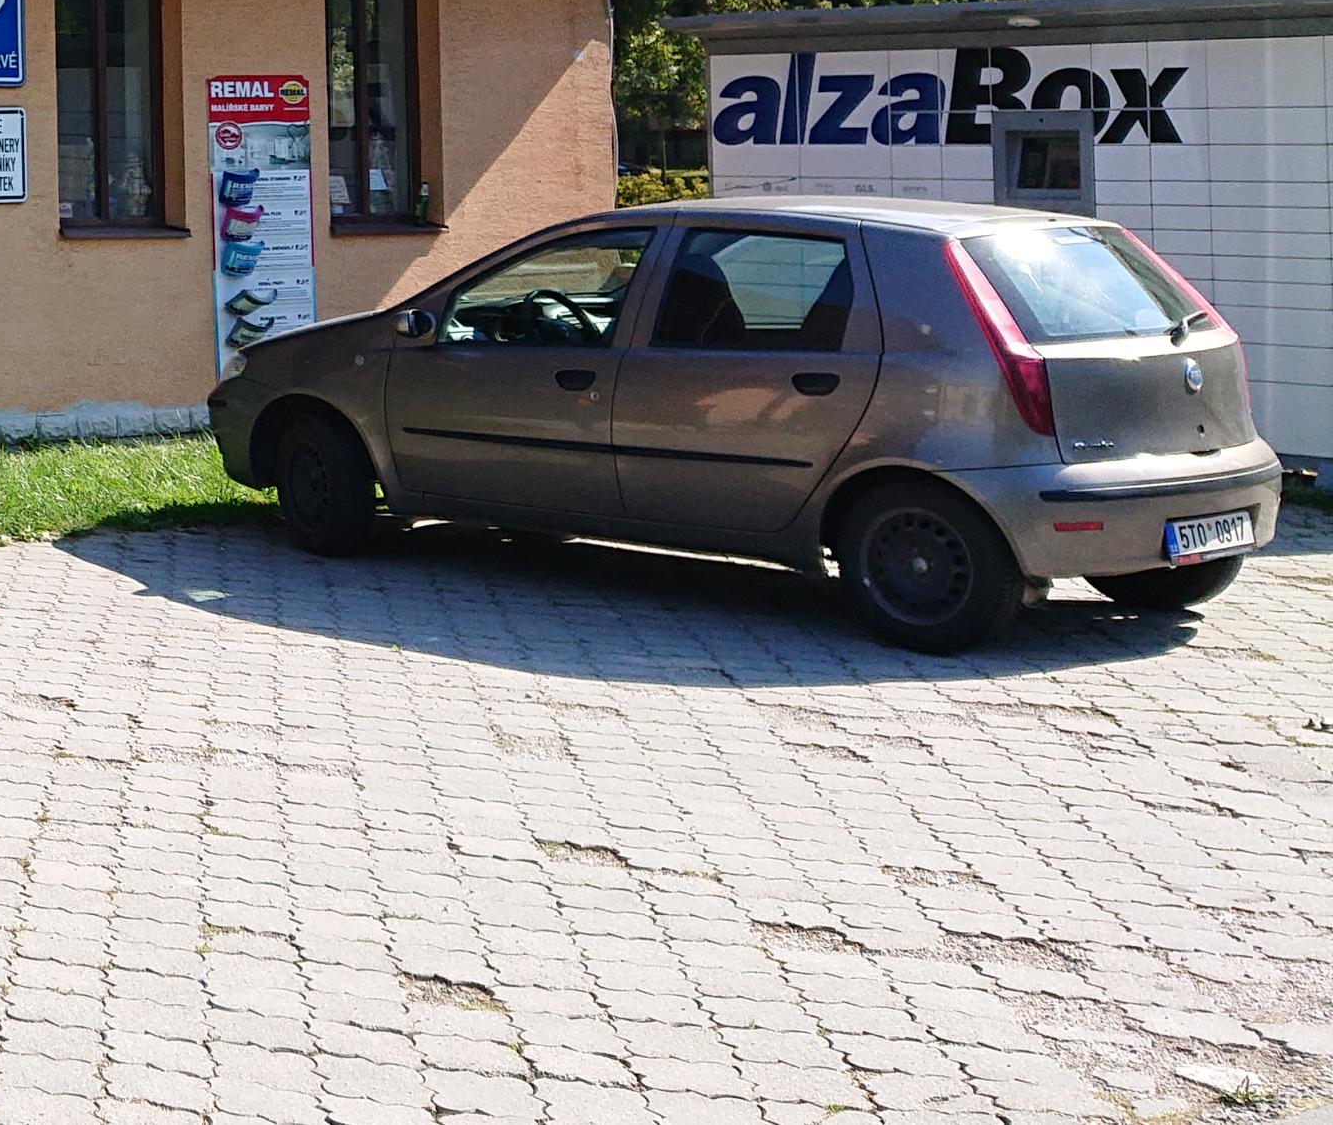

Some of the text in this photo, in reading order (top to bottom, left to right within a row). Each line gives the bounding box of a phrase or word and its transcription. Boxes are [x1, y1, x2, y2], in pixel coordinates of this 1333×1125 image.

[210, 81, 274, 97] REMAL
[280, 88, 306, 97] REMAL
[713, 47, 1189, 145] alzaBox
[250, 103, 275, 111] BARVY
[1215, 516, 1244, 544] 0917
